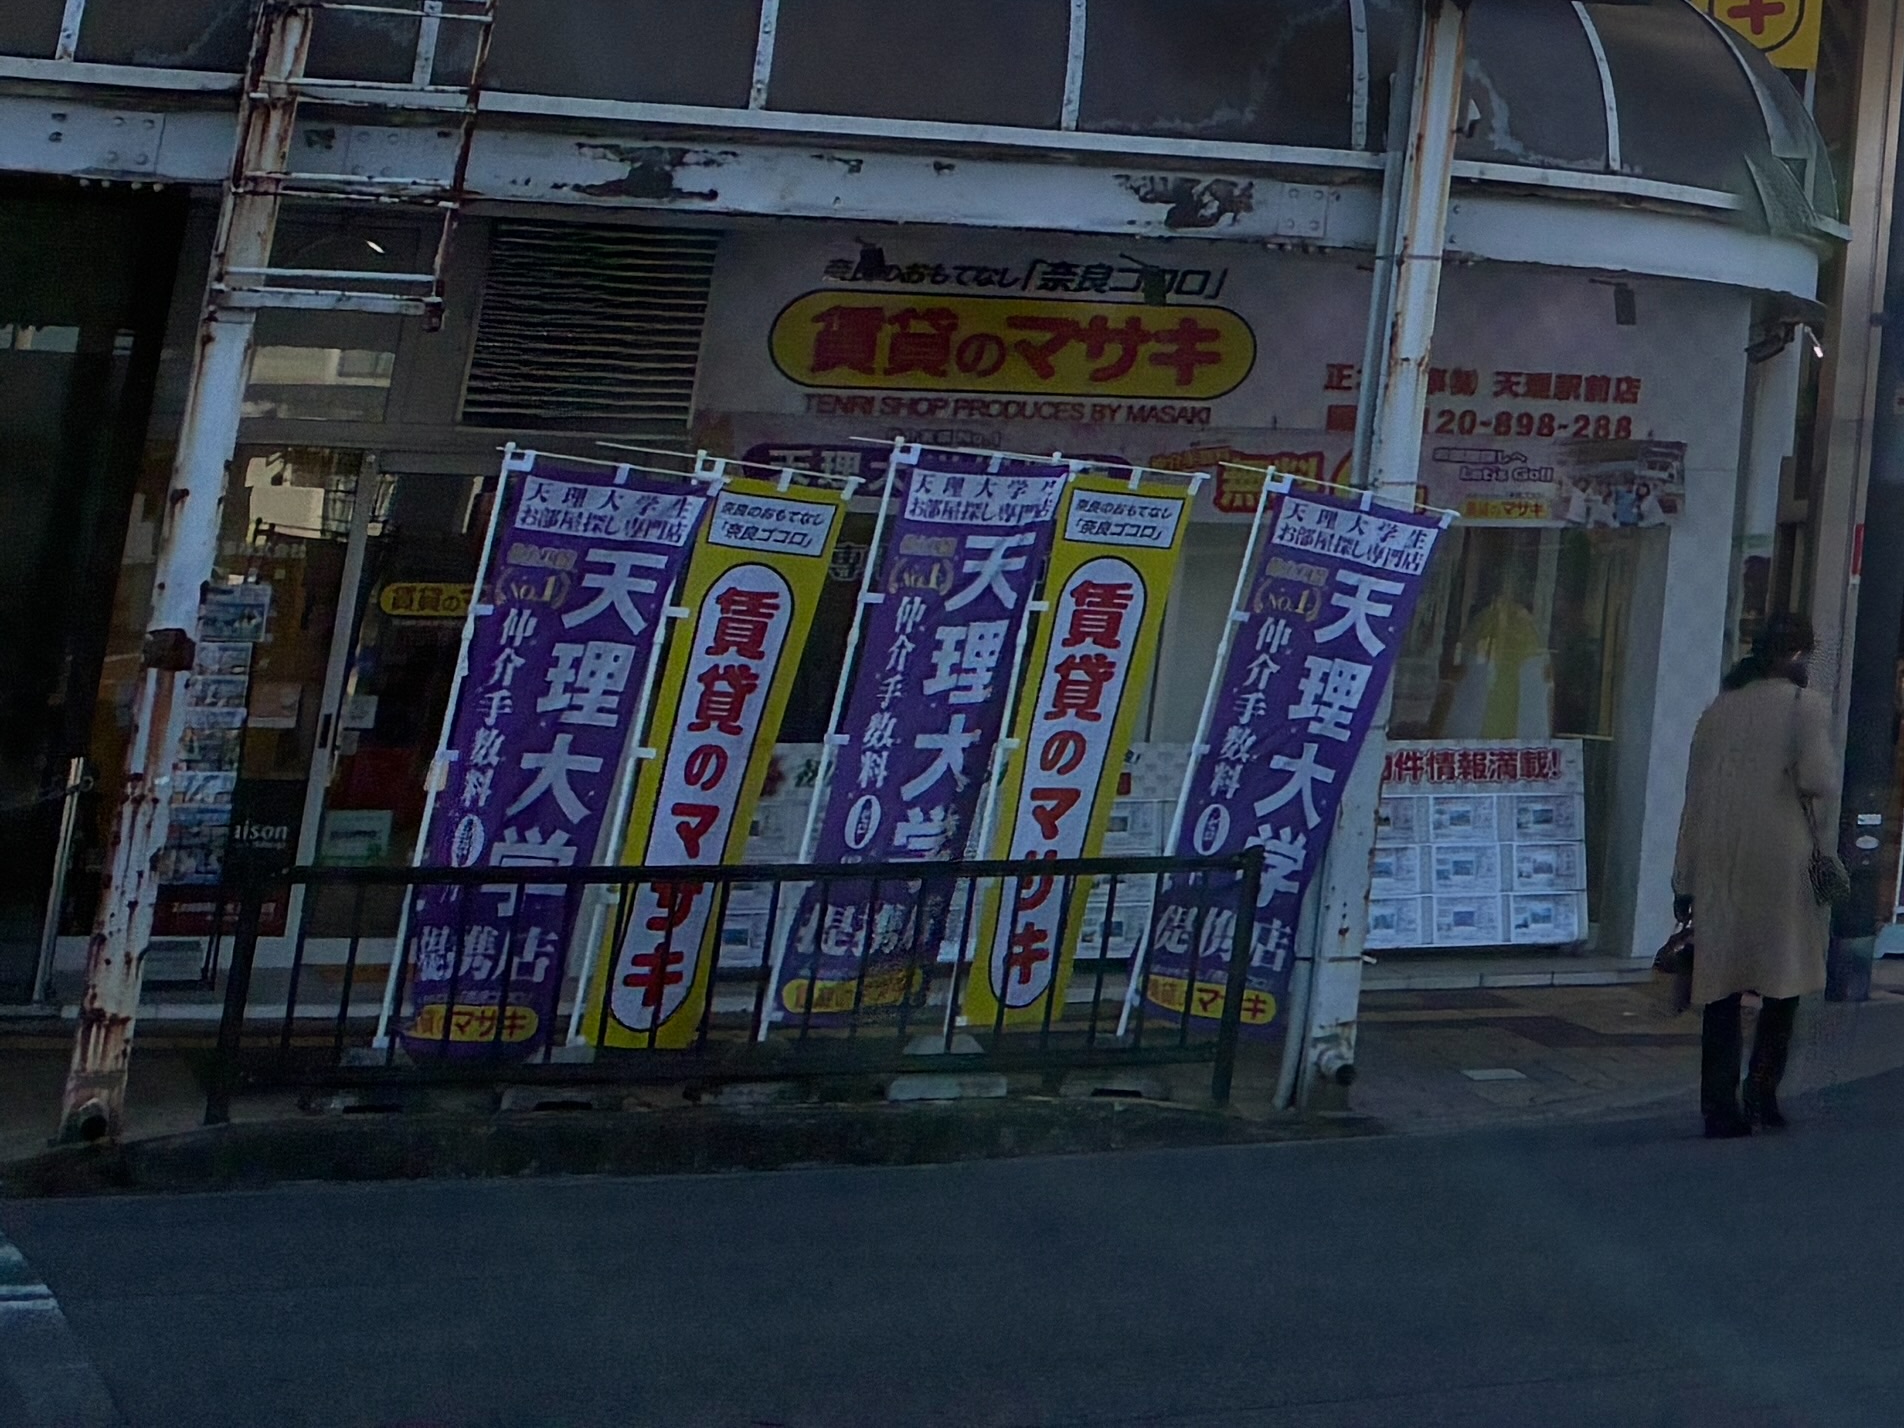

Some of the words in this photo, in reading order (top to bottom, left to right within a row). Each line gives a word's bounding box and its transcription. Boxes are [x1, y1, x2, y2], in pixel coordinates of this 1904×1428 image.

[811, 304, 1223, 387] 賃貸のマサキ
[1492, 370, 1641, 404] 天理駅前店
[805, 394, 875, 415] TENRI
[880, 396, 949, 419] SHOP
[954, 398, 1086, 422] PRODUCES
[1089, 402, 1121, 424] BY
[1126, 404, 1212, 425] MASAKI
[1422, 407, 1633, 439] 120-898-288
[526, 480, 693, 520] 天理大学生
[720, 502, 826, 527] 奈良のおもてなし
[1076, 497, 1173, 520] 奈良のおもてなし
[520, 506, 688, 544] お部屋探し専門店
[722, 520, 814, 548] 「奈良ゴコロ」
[1073, 517, 1163, 542] 「奈良ゴコロ」
[1283, 496, 1428, 548] 天理大学生
[1275, 522, 1423, 576] お部屋探し専門店
[1244, 569, 1405, 908] 天理大学
